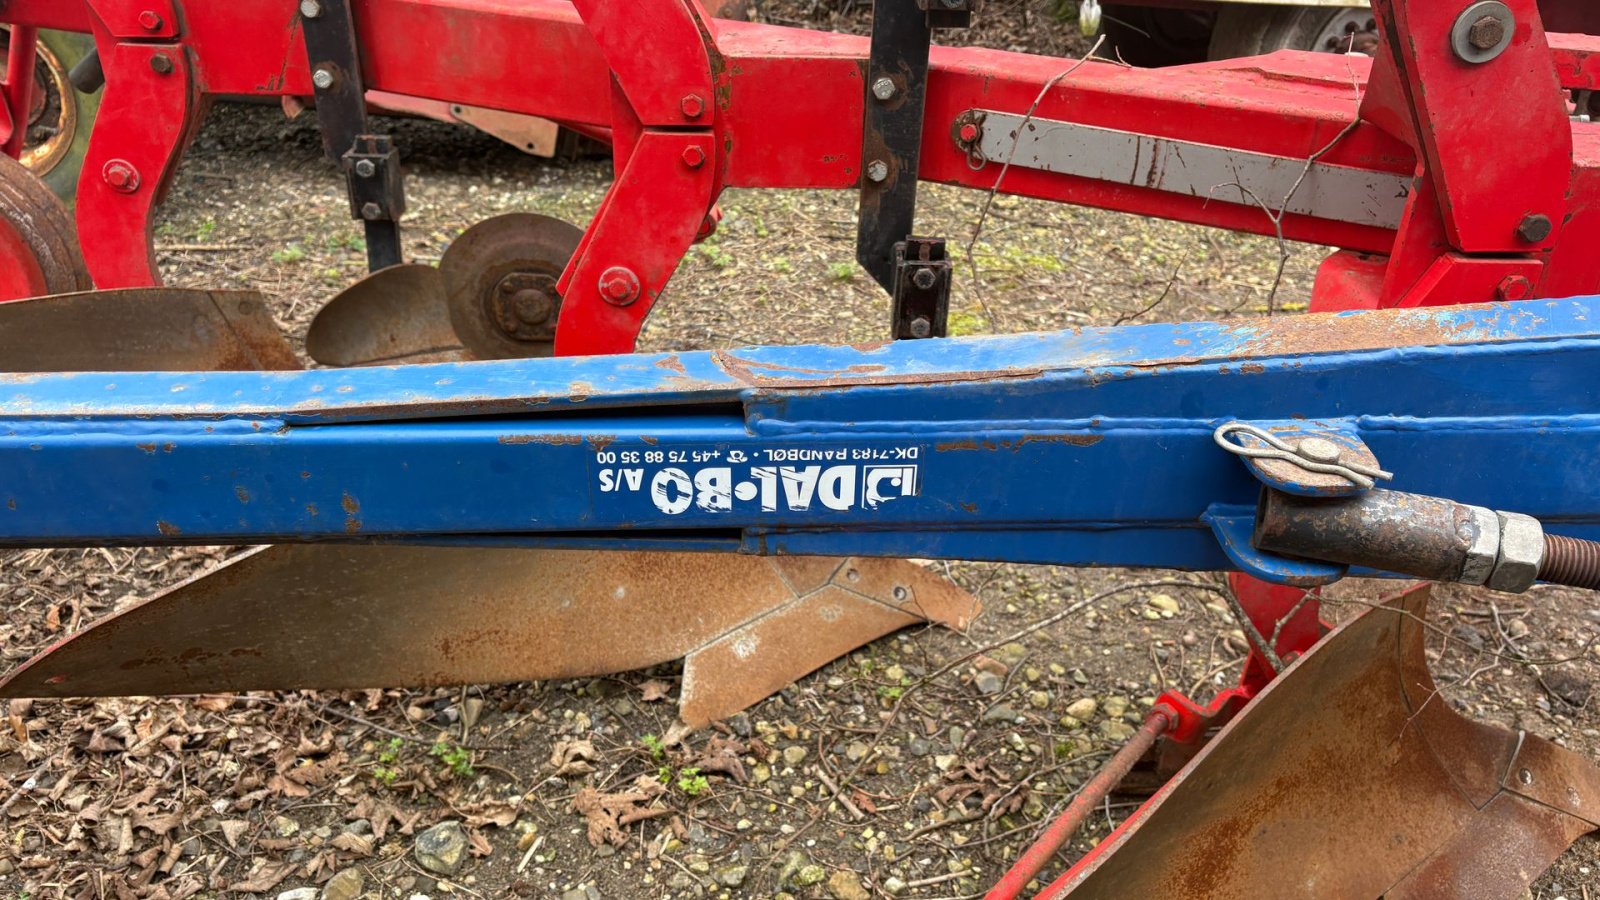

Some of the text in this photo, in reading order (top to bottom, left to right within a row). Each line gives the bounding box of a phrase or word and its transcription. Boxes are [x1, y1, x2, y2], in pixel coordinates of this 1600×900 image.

[597, 447, 918, 464] DK-7183 RANDBØL +45 75 88 35 00
[599, 468, 644, 492] A/S
